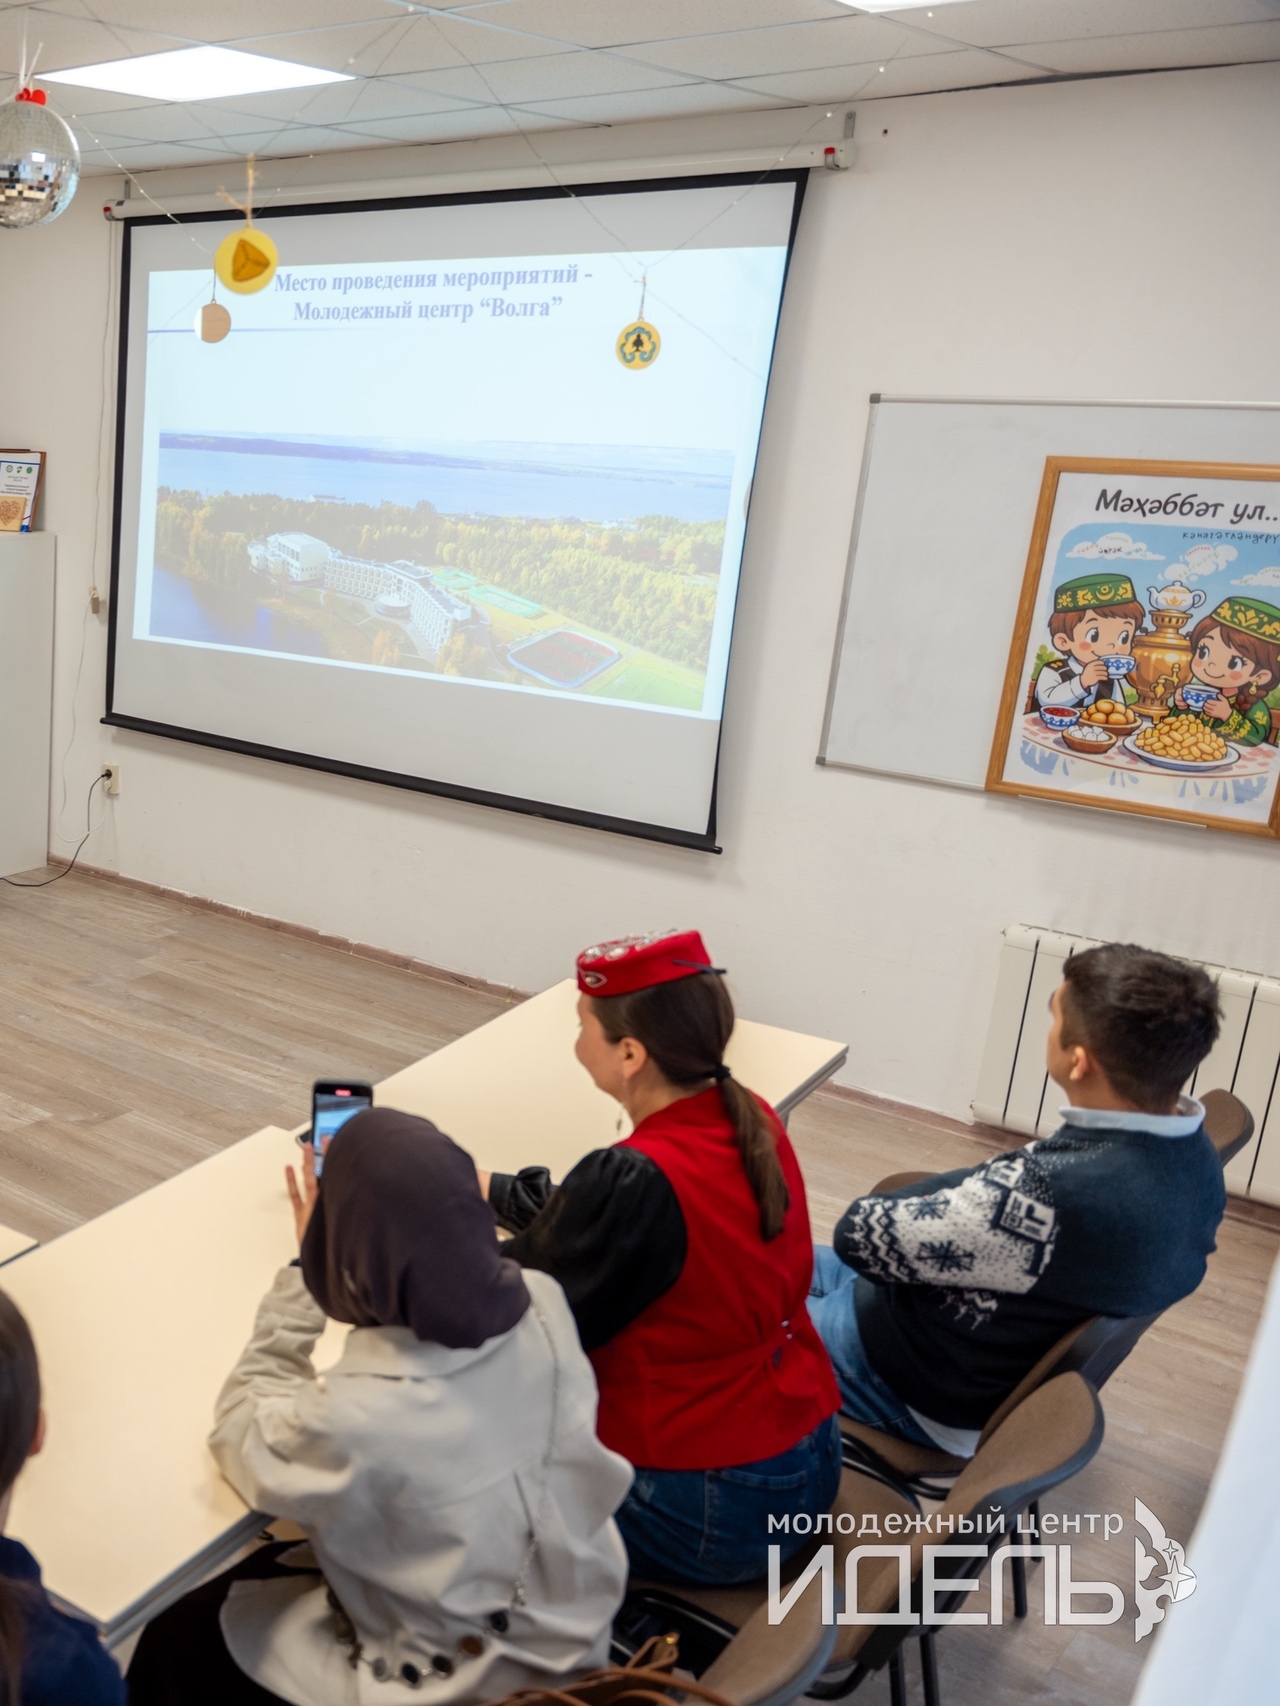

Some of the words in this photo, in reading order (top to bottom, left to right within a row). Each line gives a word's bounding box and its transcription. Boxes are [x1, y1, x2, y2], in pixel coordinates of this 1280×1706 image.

[274, 273, 327, 292] Место
[332, 272, 437, 295] проведения
[443, 263, 579, 292] мероприятий
[293, 300, 413, 322] Молодежный
[418, 303, 474, 323] центр
[1095, 488, 1224, 518] Мәхәббәт
